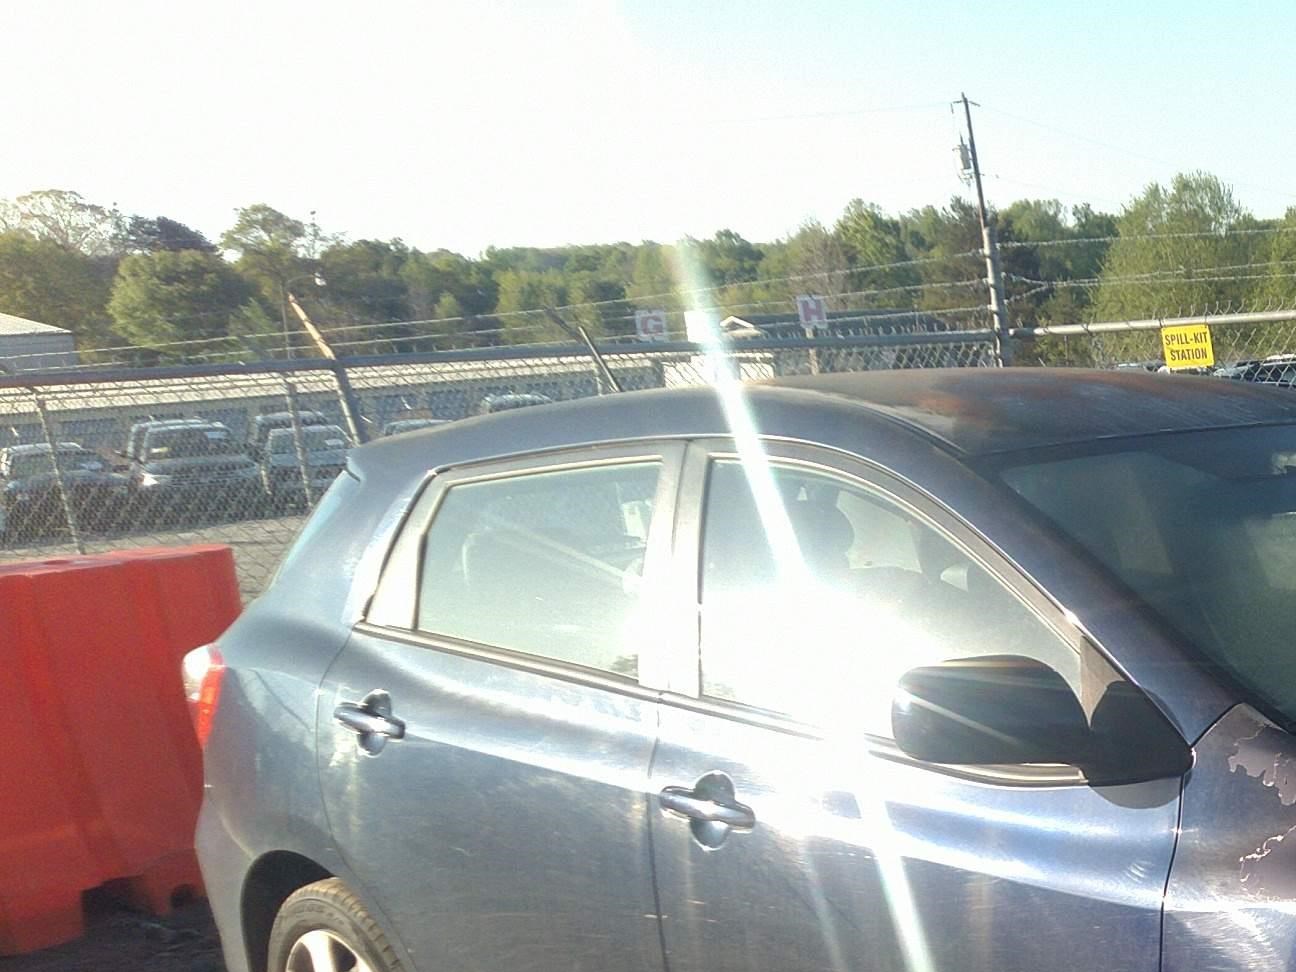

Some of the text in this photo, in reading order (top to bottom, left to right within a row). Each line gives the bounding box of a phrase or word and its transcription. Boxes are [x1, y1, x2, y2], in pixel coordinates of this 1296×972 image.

[802, 299, 825, 321] H
[1165, 332, 1208, 346] SPILL-KIT
[1170, 347, 1208, 361] STATION
